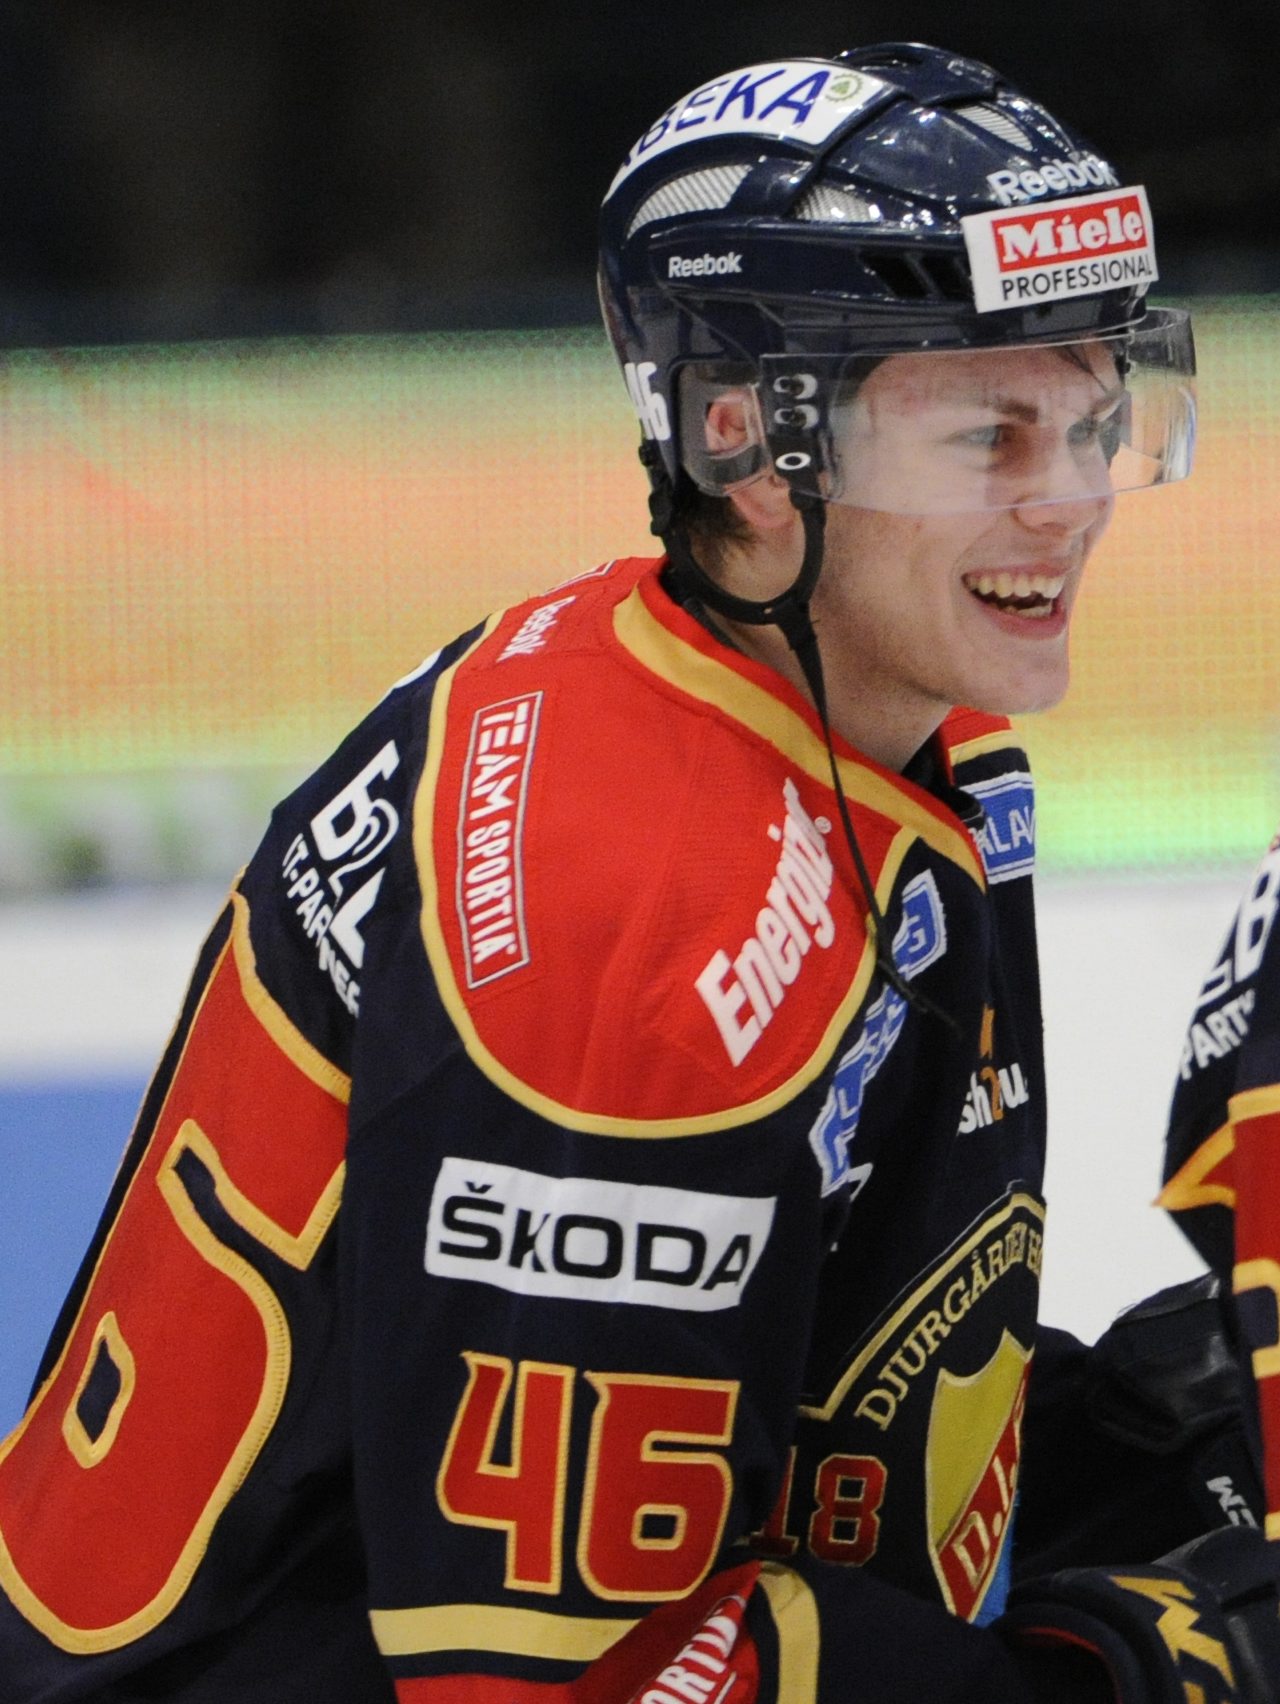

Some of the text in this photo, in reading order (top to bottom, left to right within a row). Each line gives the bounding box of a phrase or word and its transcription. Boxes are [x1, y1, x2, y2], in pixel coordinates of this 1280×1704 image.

[625, 68, 831, 166] BEKA
[986, 153, 1121, 206] Reebok
[668, 251, 743, 278] Reebok
[997, 206, 1143, 264] Miele
[1002, 255, 1152, 301] PROFESSIONAL
[464, 700, 531, 966] TEAM SPORTIA
[438, 1181, 752, 1291] ŠKODA
[436, 1350, 740, 1601] 46
